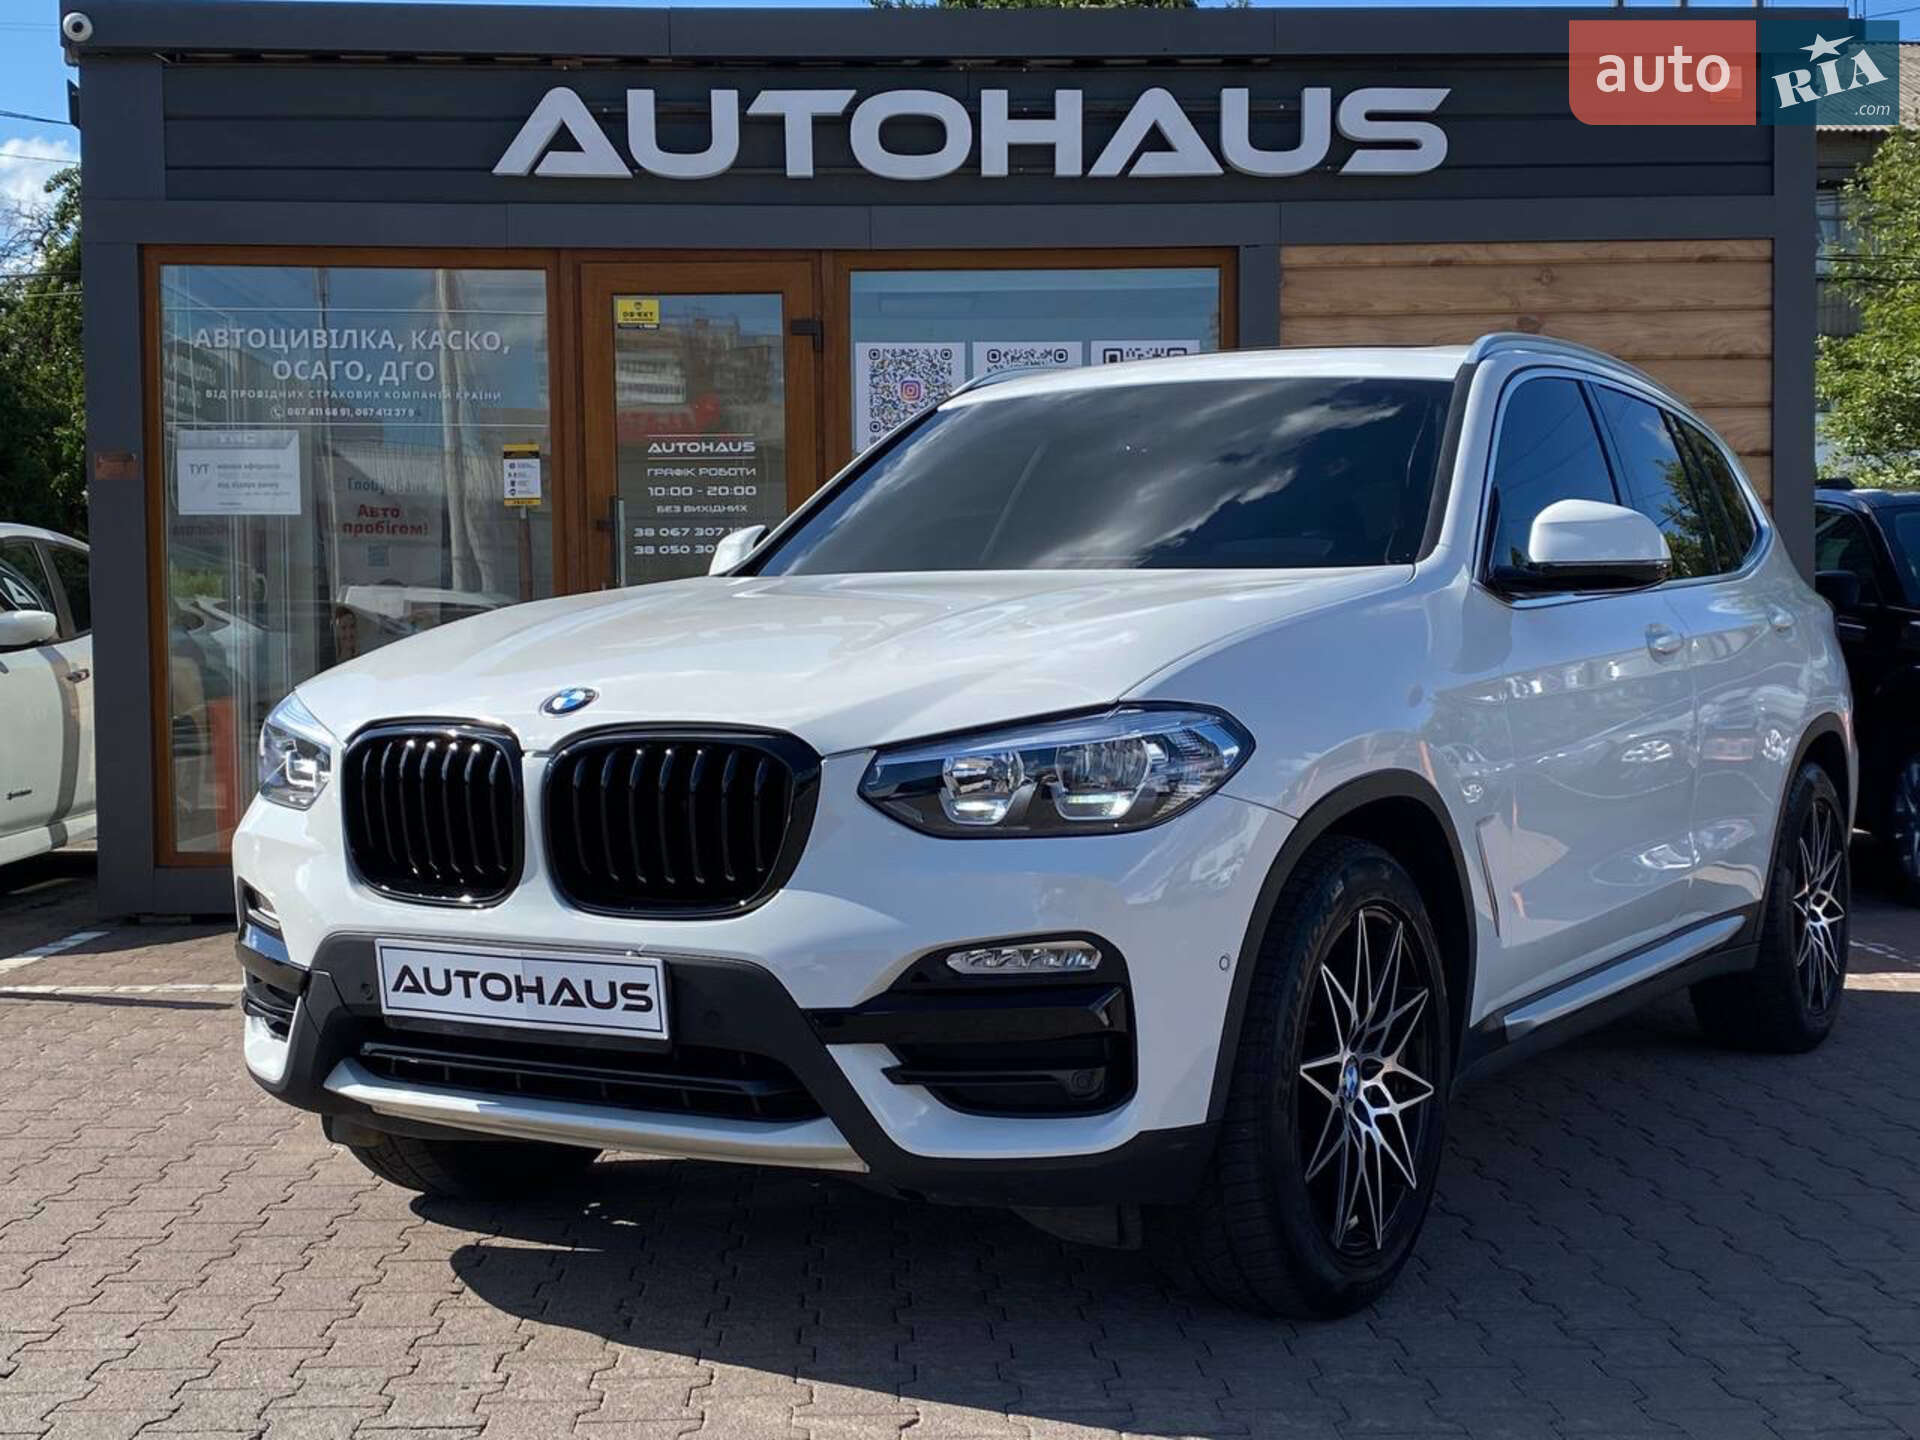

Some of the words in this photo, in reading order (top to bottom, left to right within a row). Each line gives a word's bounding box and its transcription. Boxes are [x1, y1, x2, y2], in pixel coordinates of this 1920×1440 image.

[491, 86, 1453, 180] AUTOHAUS
[193, 327, 404, 354] АВТОЦИВІЛКА,
[411, 329, 511, 354] КАСКО,
[272, 359, 372, 383] ОСАГО,
[379, 360, 435, 387] ДГО
[205, 389, 228, 400] ВІД
[308, 389, 381, 400] СТРАХОВИХ
[647, 441, 756, 453] AUTOHAUS
[647, 467, 697, 477] ГРАФІК
[699, 467, 757, 477] РОБОТИ
[647, 486, 693, 496] 10:00
[706, 485, 757, 496] 20:00
[358, 503, 402, 520] Авто
[656, 504, 681, 514] БЕЗ
[683, 504, 748, 514] ВИХІДНИХ
[633, 527, 655, 538] 38
[659, 527, 691, 537] 067
[694, 527, 725, 537] 307
[633, 545, 655, 555] 38
[659, 544, 691, 554] 050
[694, 544, 719, 554] 30
[391, 964, 654, 1013] AUTOHAUS
